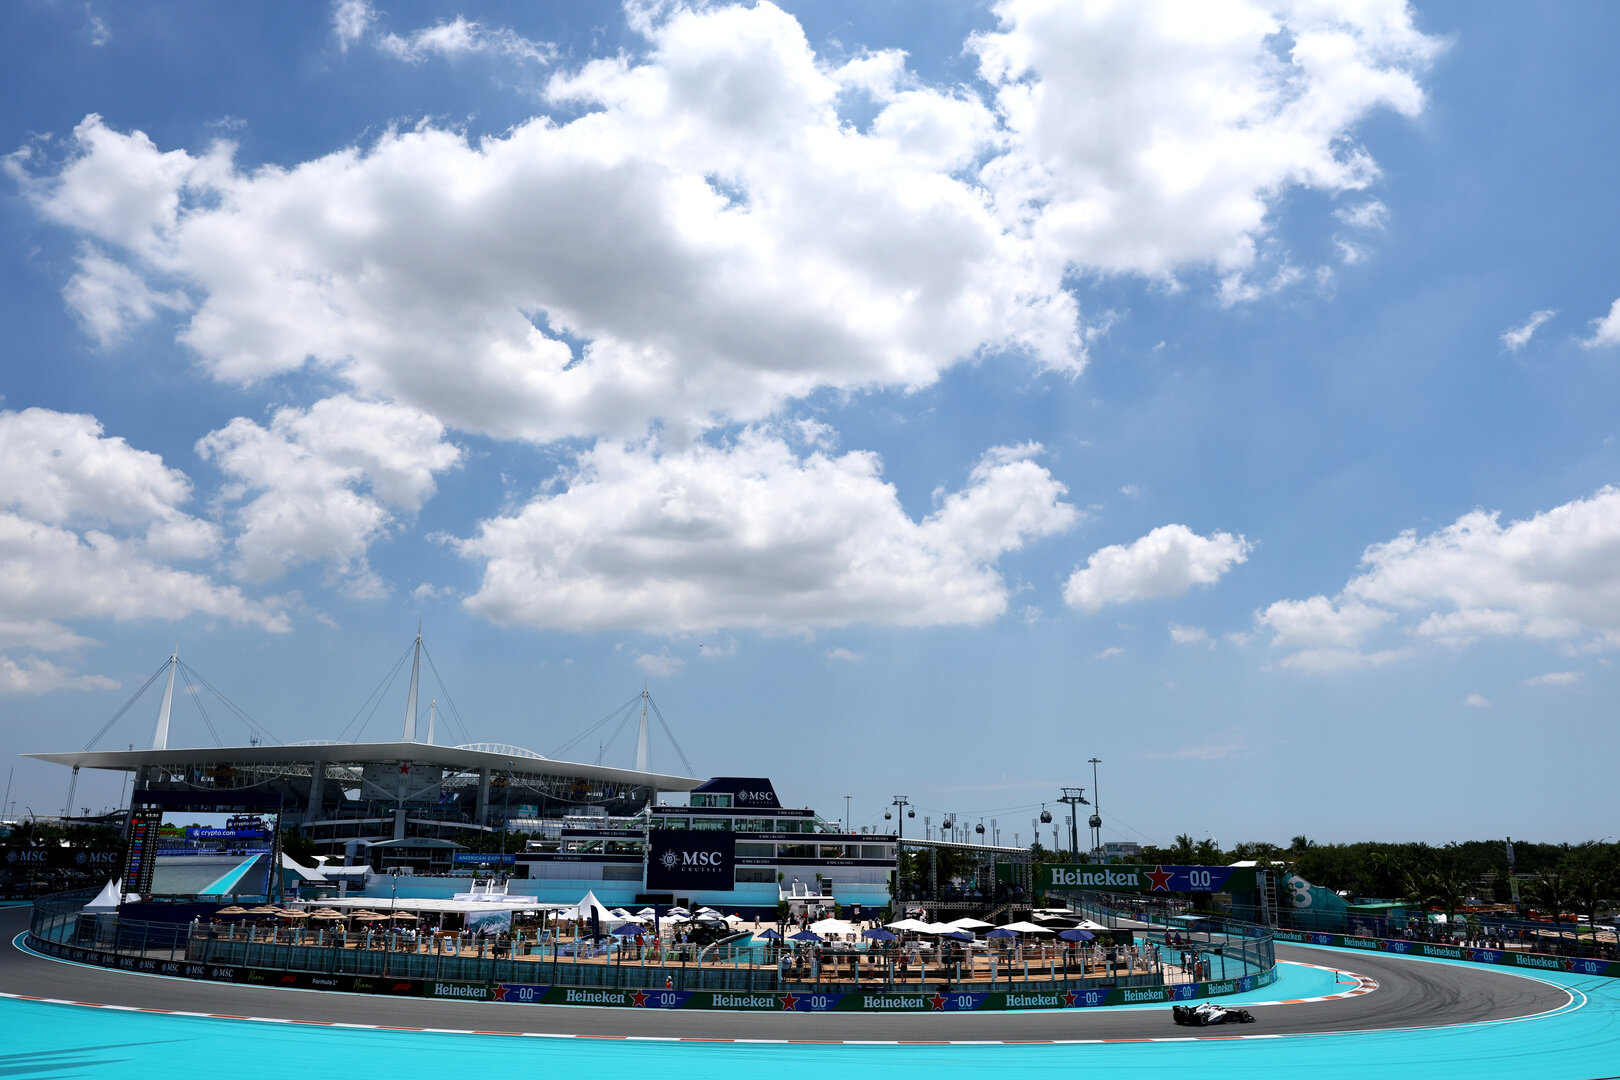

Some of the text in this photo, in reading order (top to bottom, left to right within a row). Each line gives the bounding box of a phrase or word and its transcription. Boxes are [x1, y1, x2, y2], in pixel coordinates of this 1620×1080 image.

[748, 791, 773, 800] MSC
[20, 850, 48, 861] MSC
[89, 852, 118, 863] MSC
[682, 851, 722, 866] MSC
[1051, 868, 1211, 887] Heineken 0.0
[1273, 931, 1303, 942] Heineken
[1343, 937, 1377, 949] Heineken
[1423, 945, 1461, 959] Heineken
[143, 960, 156, 969] MSC
[166, 963, 180, 972] MSC
[1515, 954, 1559, 969] Heineken
[191, 966, 205, 975] MSC
[219, 968, 234, 977] MSC
[312, 978, 332, 986] Formula
[434, 984, 534, 1000] Heineken 0.0
[1208, 983, 1234, 995] Heineken
[566, 989, 676, 1005] Heineken 0.0
[711, 993, 827, 1008] Heineken 0.0
[863, 995, 973, 1009] Heineken 0.0
[1005, 992, 1098, 1007] Heineken 0.0
[1124, 990, 1164, 1002] Heineken
